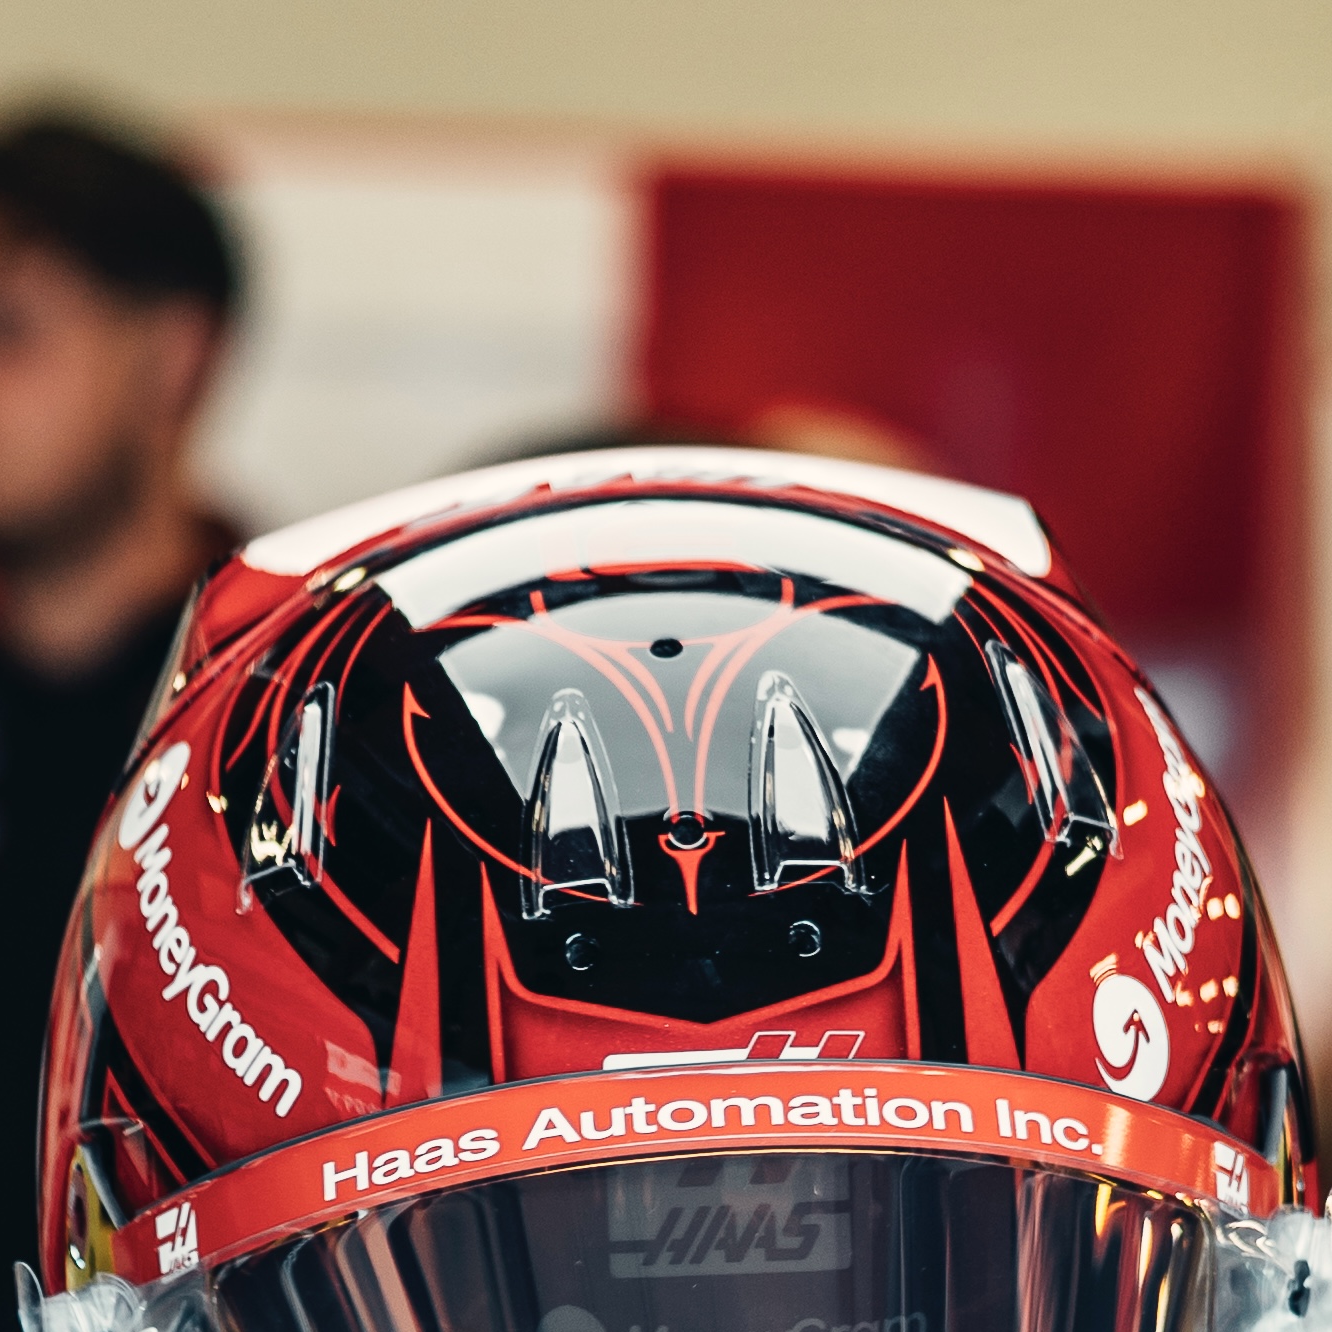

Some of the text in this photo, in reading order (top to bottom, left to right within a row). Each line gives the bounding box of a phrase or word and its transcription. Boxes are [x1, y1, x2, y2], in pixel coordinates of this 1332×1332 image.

[134, 822, 303, 1118] MoneyGram
[322, 1087, 1105, 1202] Haas Automation Inc.
